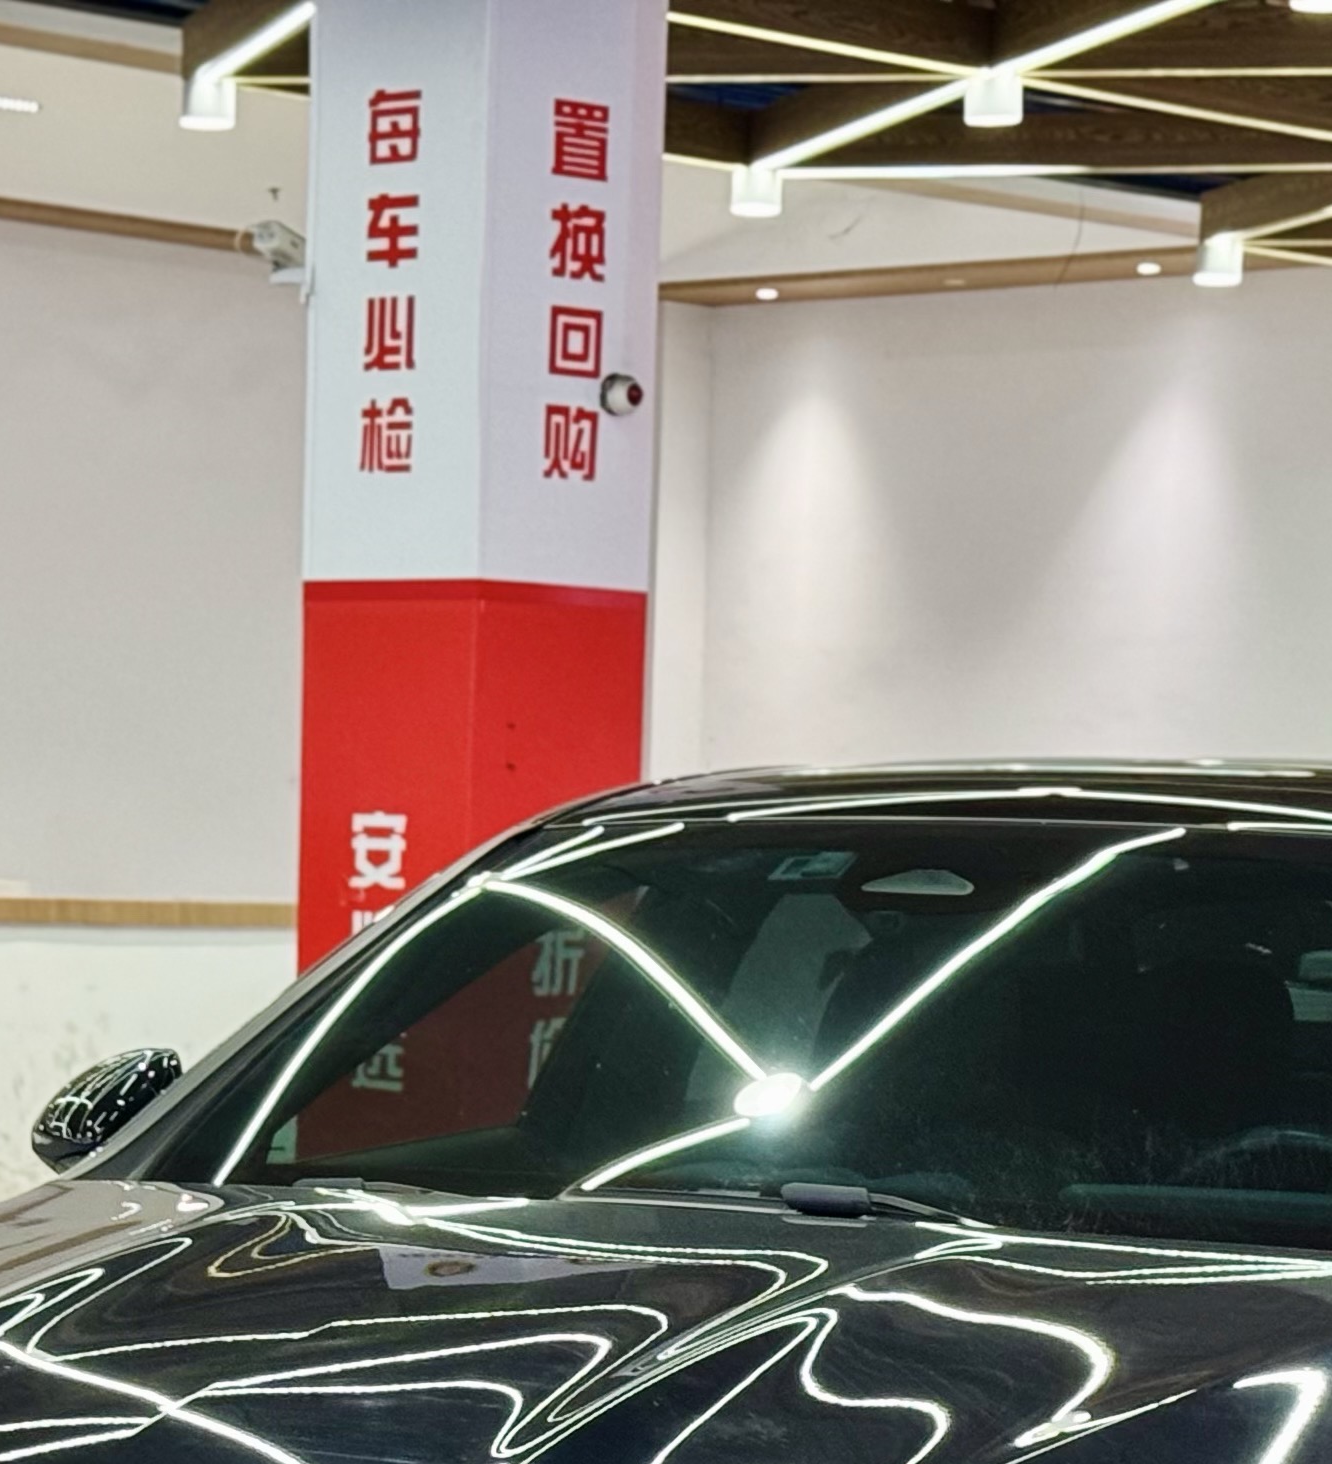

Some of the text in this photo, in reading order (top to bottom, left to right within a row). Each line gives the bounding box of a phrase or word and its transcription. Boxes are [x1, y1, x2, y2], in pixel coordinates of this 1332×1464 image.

[360, 89, 422, 473] 每车必检
[543, 98, 609, 482] 置换回购
